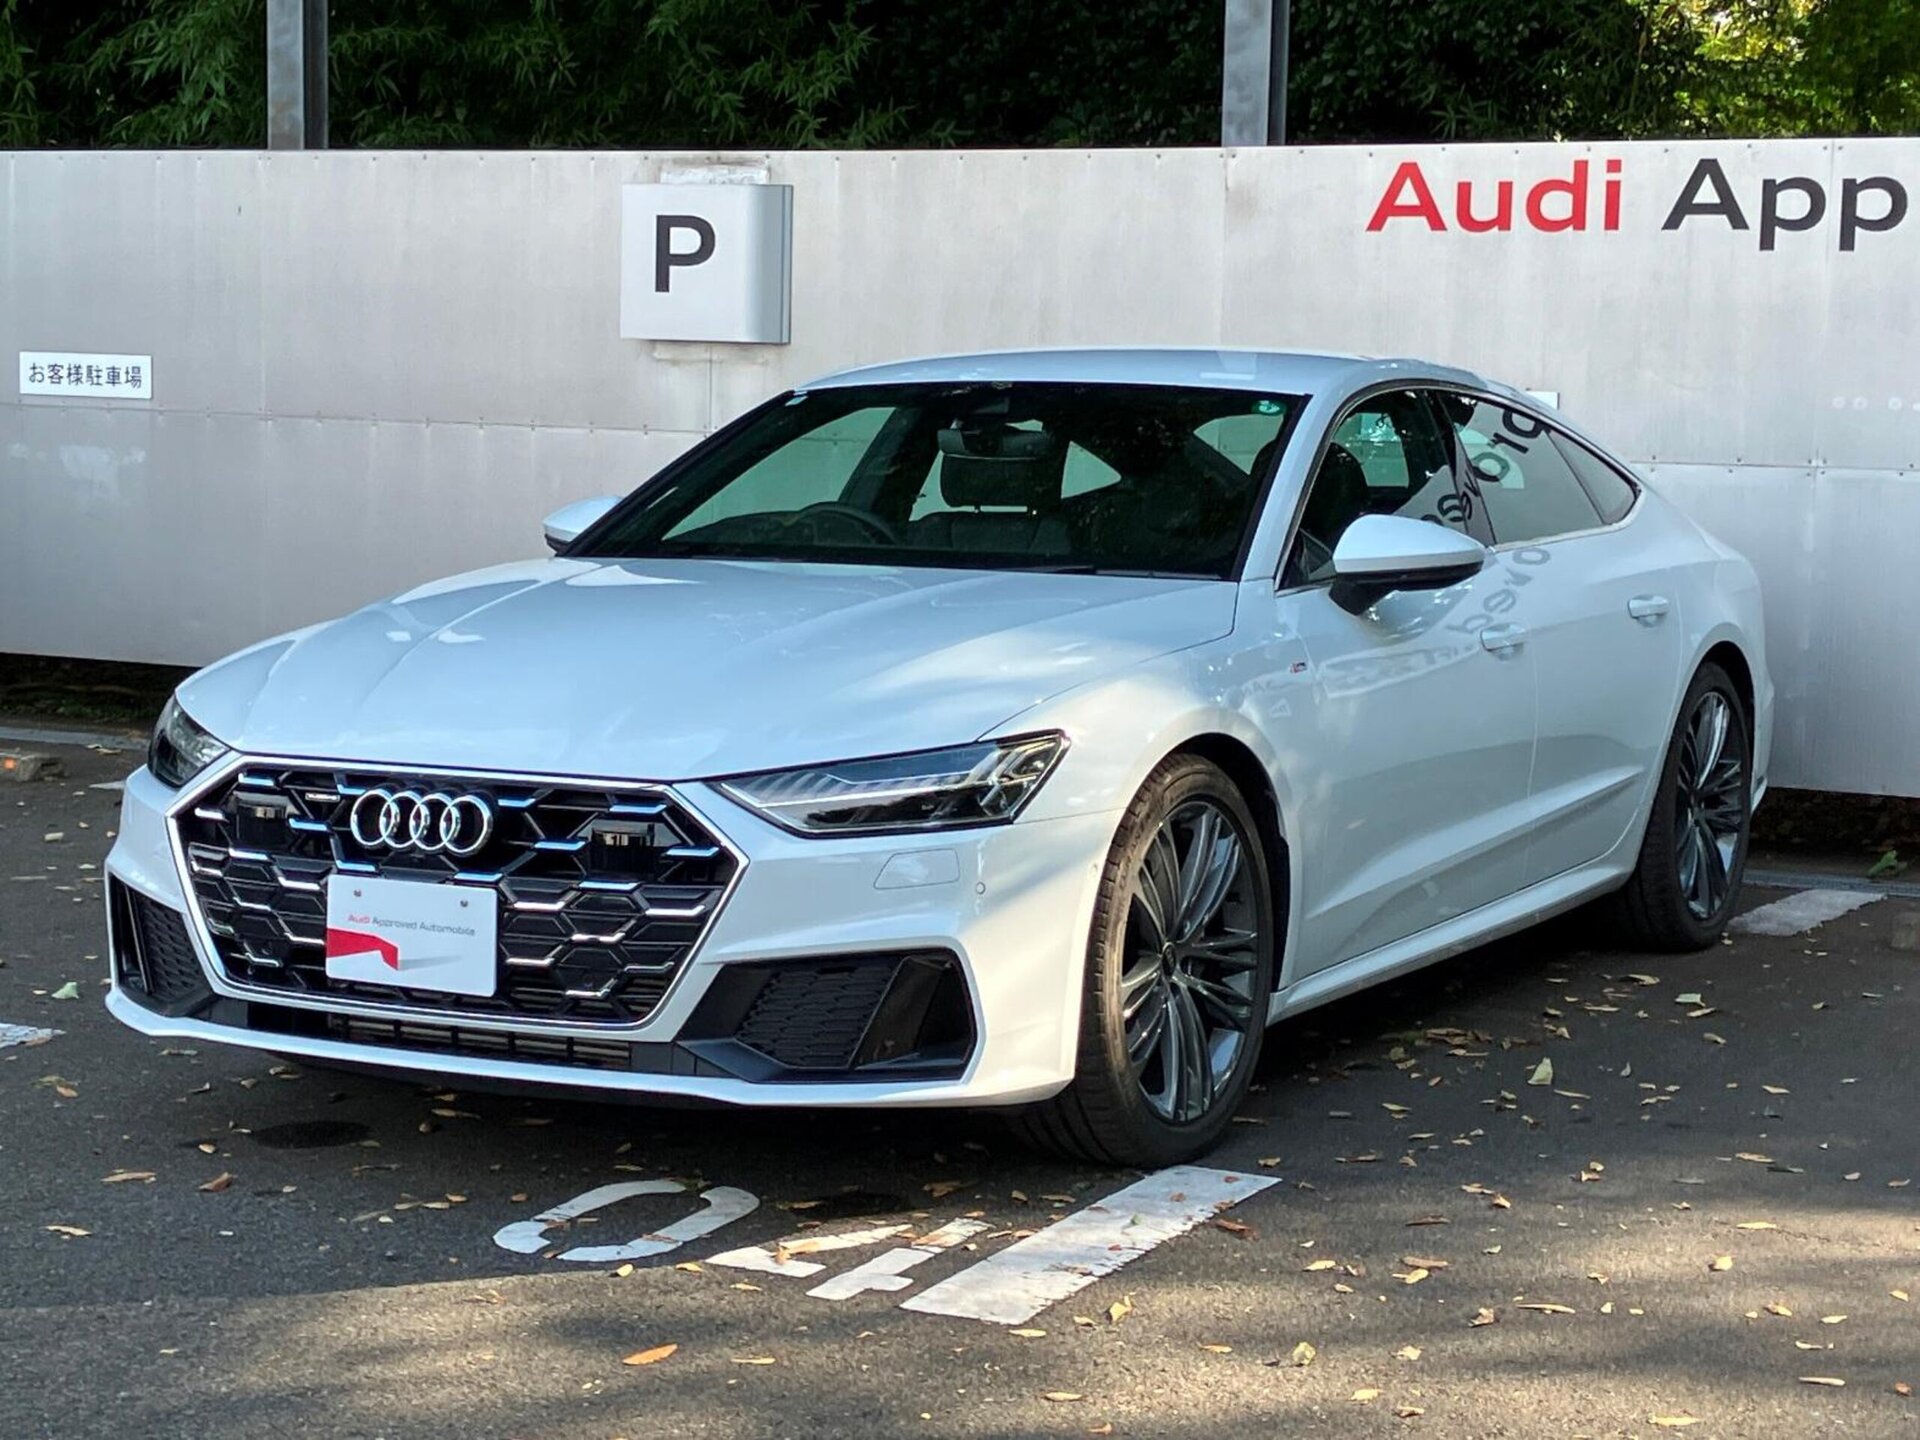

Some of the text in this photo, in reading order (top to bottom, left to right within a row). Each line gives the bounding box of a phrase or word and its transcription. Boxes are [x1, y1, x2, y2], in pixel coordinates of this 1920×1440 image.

[1365, 158, 1909, 252] Audi App
[655, 214, 716, 293] P
[28, 362, 143, 389] お客様駐車場
[347, 913, 476, 937] Audi Approved Automobile
